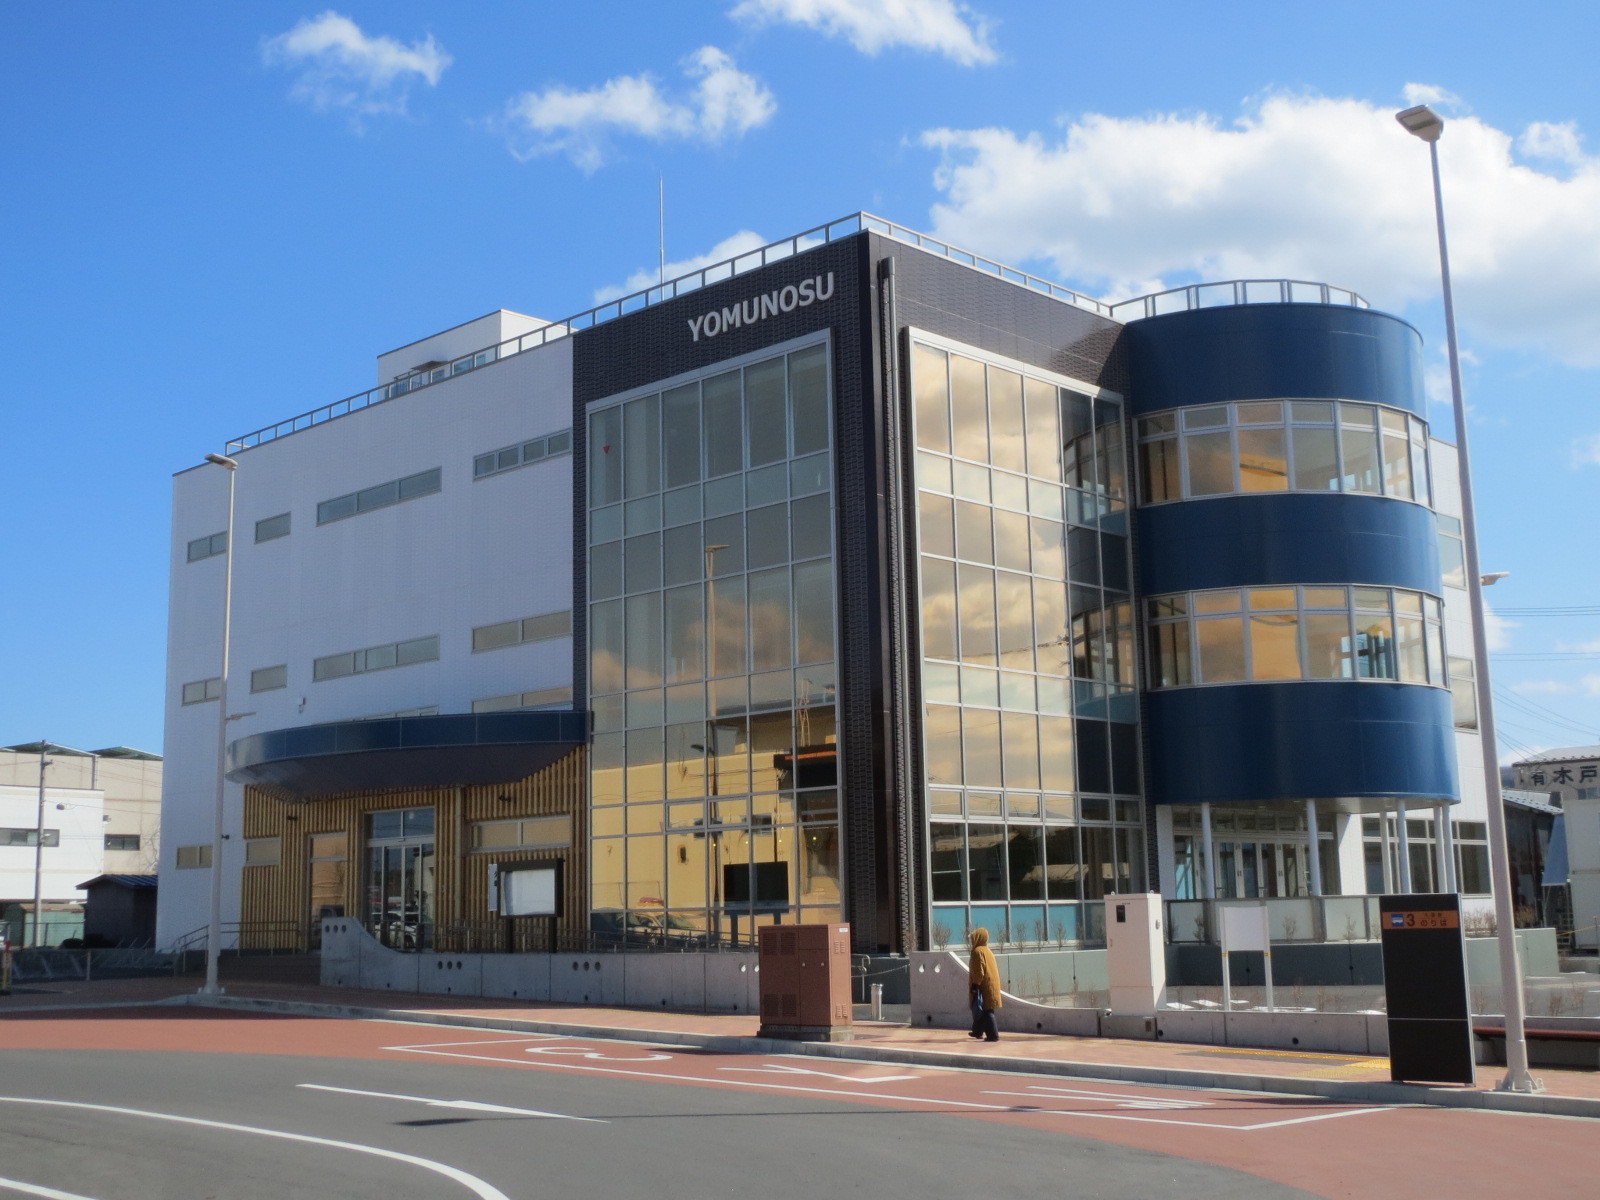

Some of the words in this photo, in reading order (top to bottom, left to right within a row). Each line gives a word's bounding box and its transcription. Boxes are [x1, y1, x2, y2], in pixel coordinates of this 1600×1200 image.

[687, 271, 834, 342] YOMUNOSU
[1406, 913, 1415, 927] 3
[1420, 919, 1447, 927] のりば
